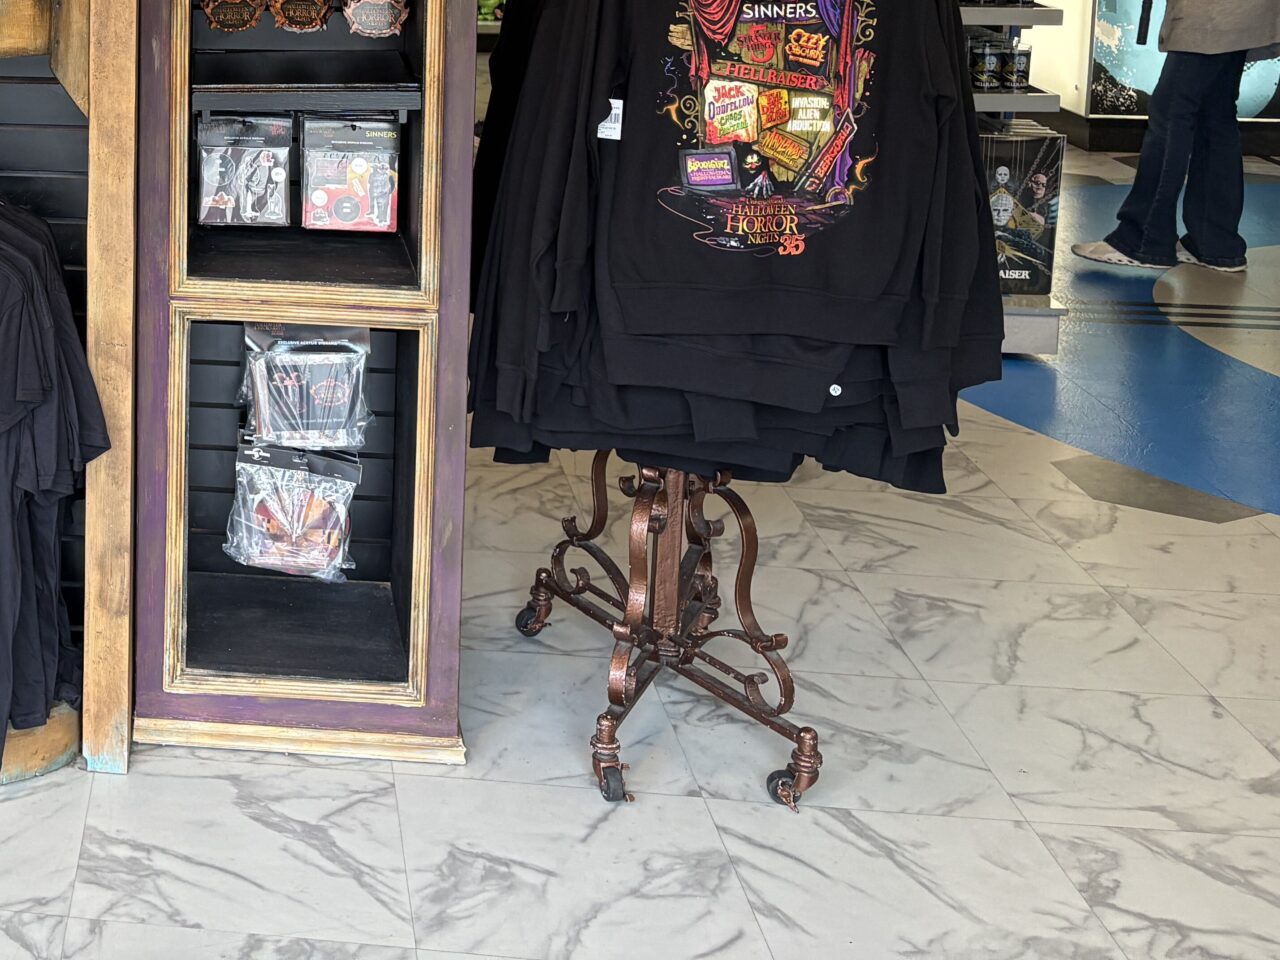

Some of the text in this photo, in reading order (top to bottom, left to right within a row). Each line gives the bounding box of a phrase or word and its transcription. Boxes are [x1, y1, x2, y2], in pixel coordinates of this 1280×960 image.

[285, 8, 318, 18] HORROR
[788, 28, 830, 50] OZZY
[726, 62, 819, 91] HELLRAISER
[713, 84, 746, 103] JACK
[708, 95, 755, 121] ODDFELLOW
[365, 130, 397, 139] SINNERS
[732, 204, 797, 216] HALLOWEEN
[723, 213, 799, 235] HORROR
[747, 232, 779, 244] NIGHTS
[777, 233, 805, 256] 35
